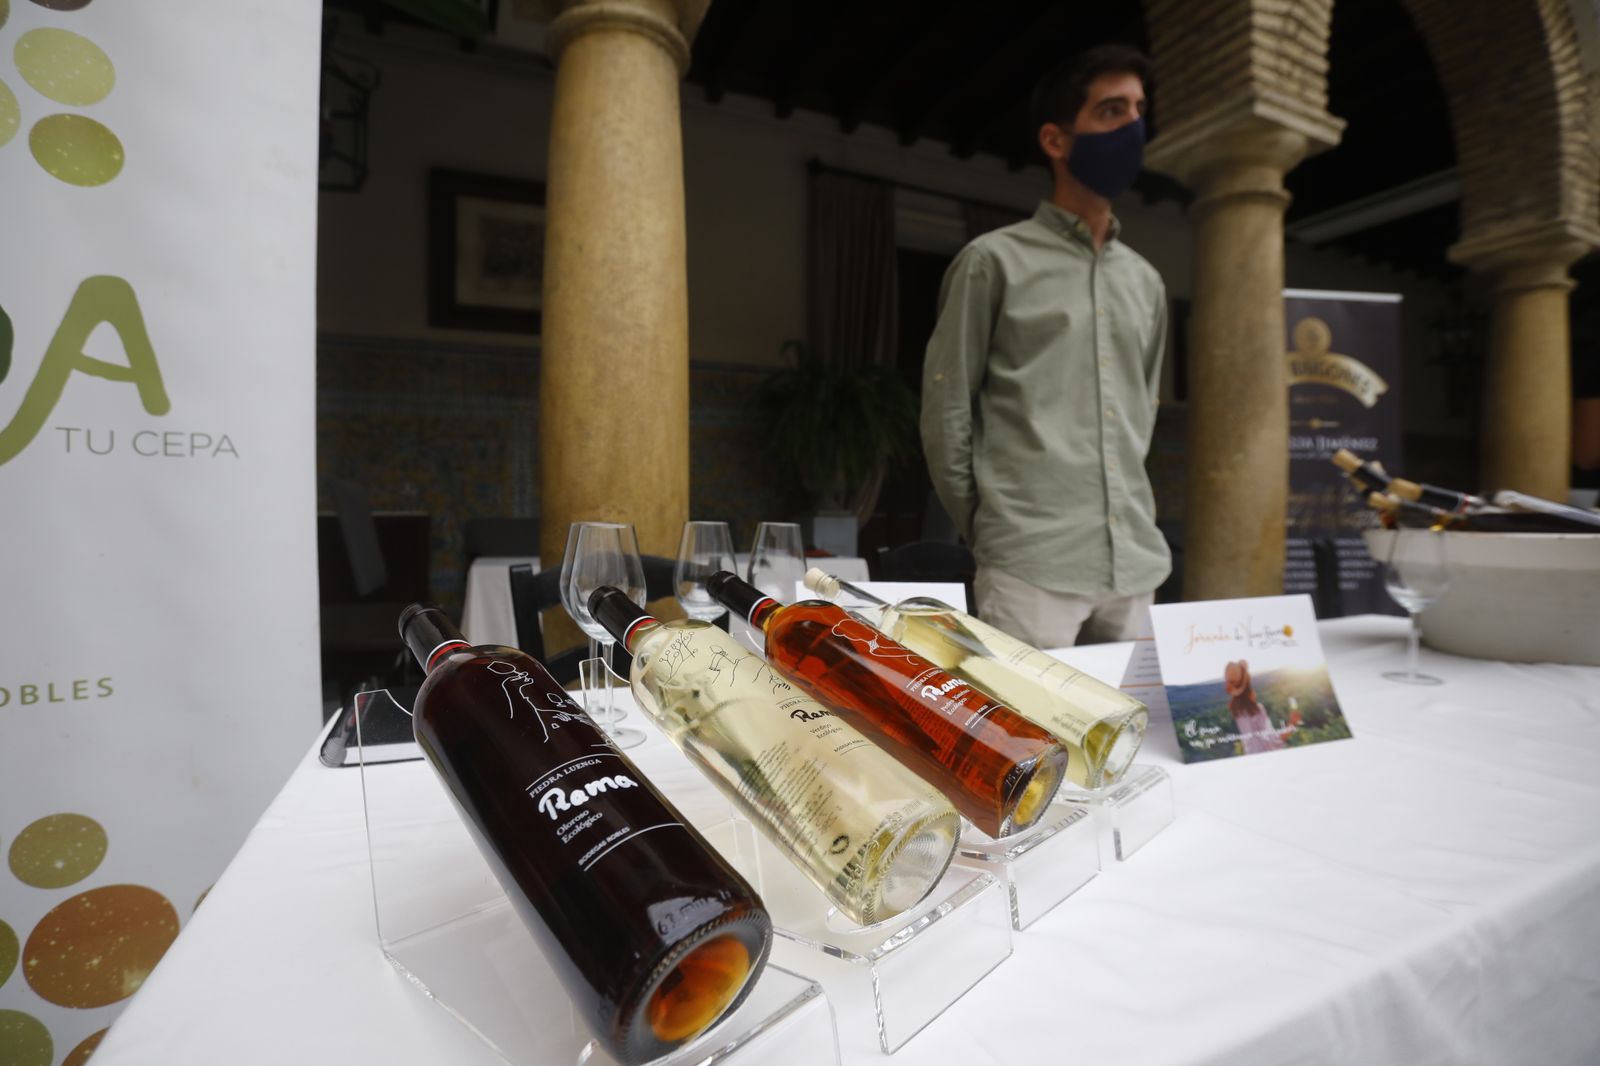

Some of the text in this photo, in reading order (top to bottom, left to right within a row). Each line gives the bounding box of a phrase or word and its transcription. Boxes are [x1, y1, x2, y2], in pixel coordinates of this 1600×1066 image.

[55, 426, 240, 459] TU CEPA
[790, 709, 832, 722] Ram
[529, 758, 602, 798] PIEDRA LUENGA
[538, 775, 639, 820] Rama
[556, 810, 590, 836] Oloroso
[561, 812, 603, 844] Ecológico
[578, 826, 631, 866] BODEGAS ROBLES
